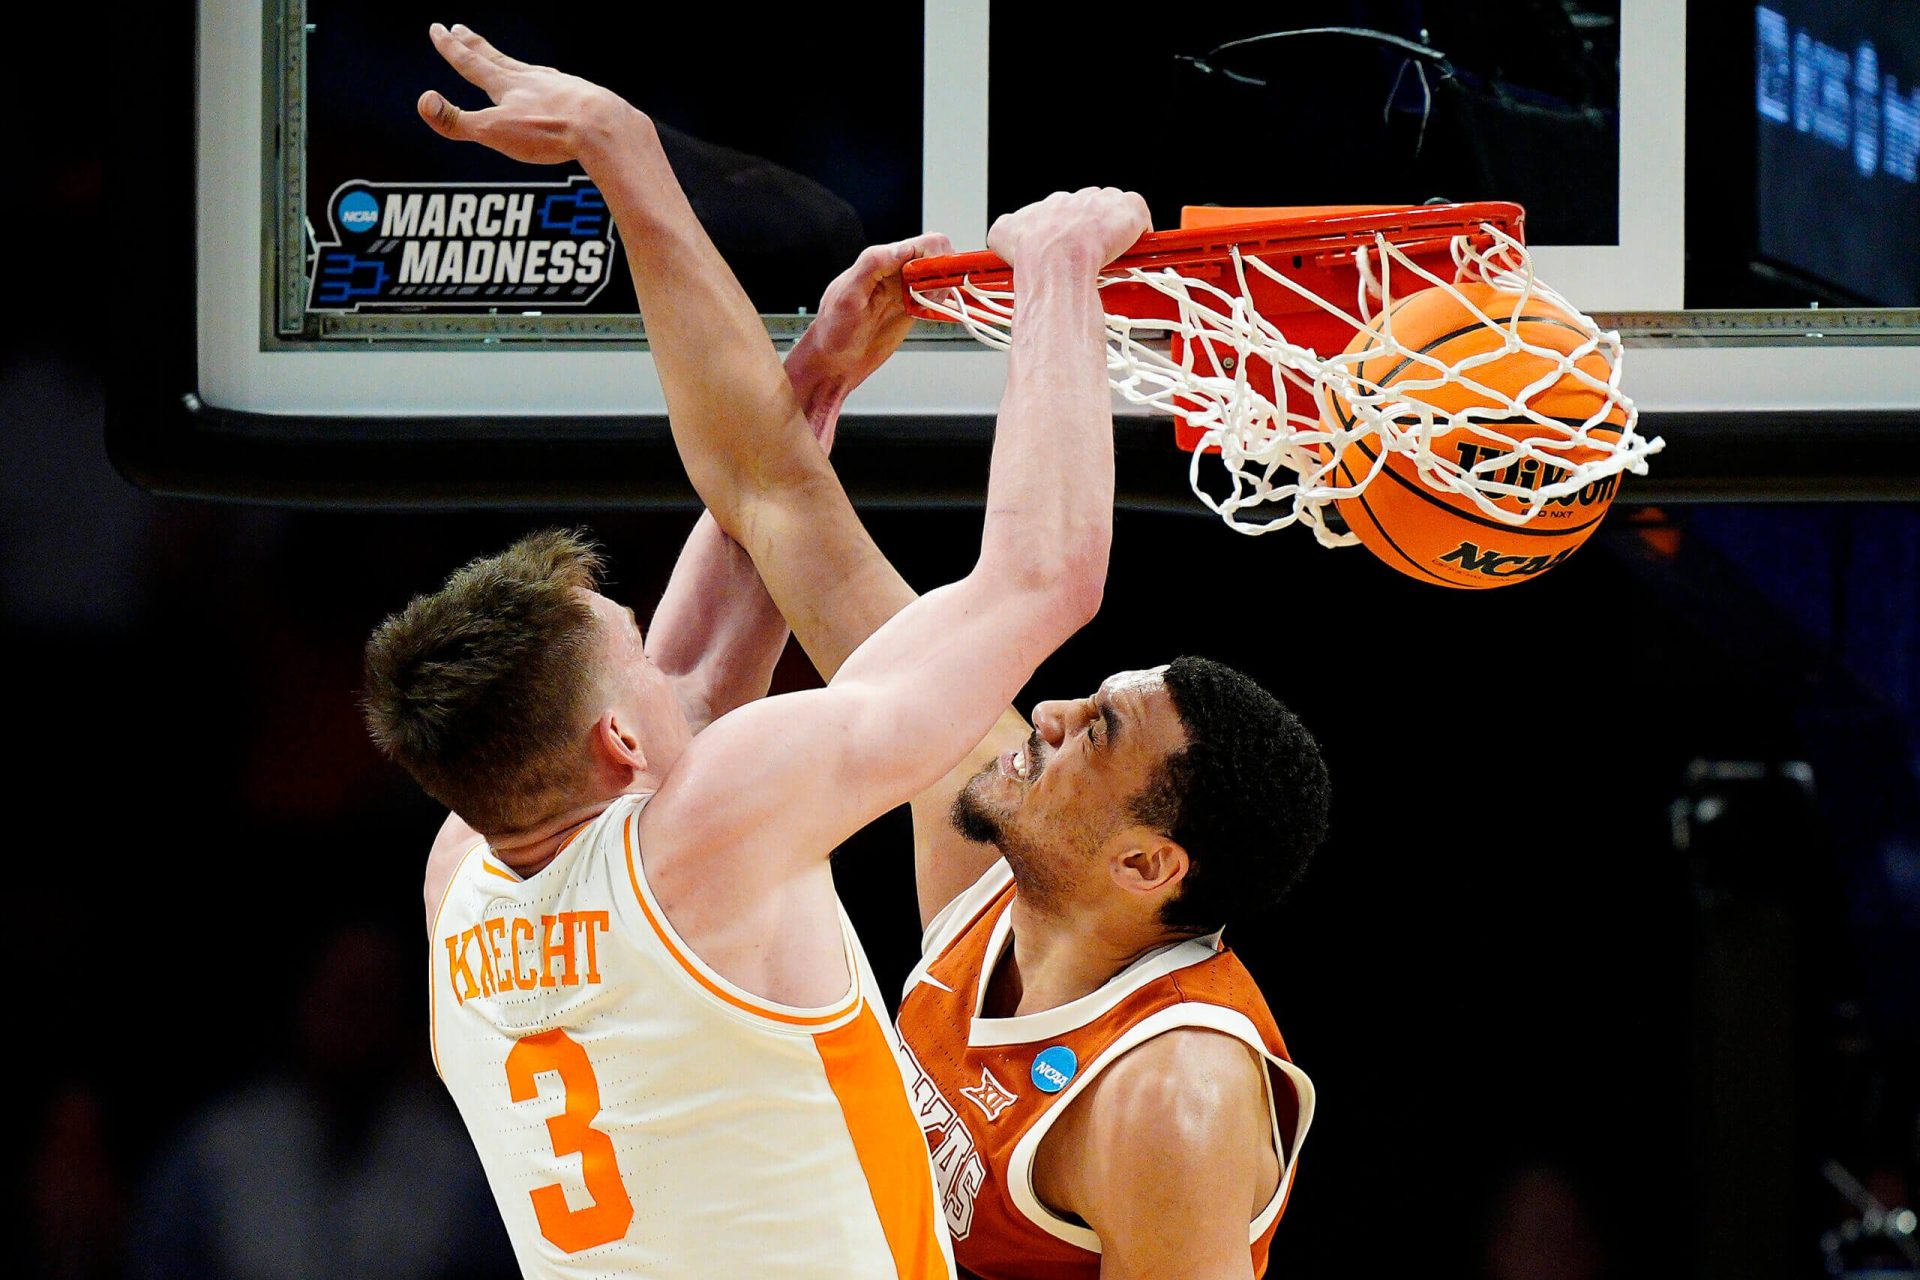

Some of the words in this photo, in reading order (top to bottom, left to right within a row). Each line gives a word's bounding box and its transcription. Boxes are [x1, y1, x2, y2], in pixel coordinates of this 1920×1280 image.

[342, 210, 378, 222] NCAA
[380, 194, 535, 237] MARCH
[398, 240, 606, 284] MADNESS
[1456, 441, 1618, 507] Wilon
[1550, 510, 1574, 519] NXT
[445, 910, 609, 1006] KNECHT
[1034, 1061, 1069, 1088] NCAA
[505, 1027, 634, 1254] 3
